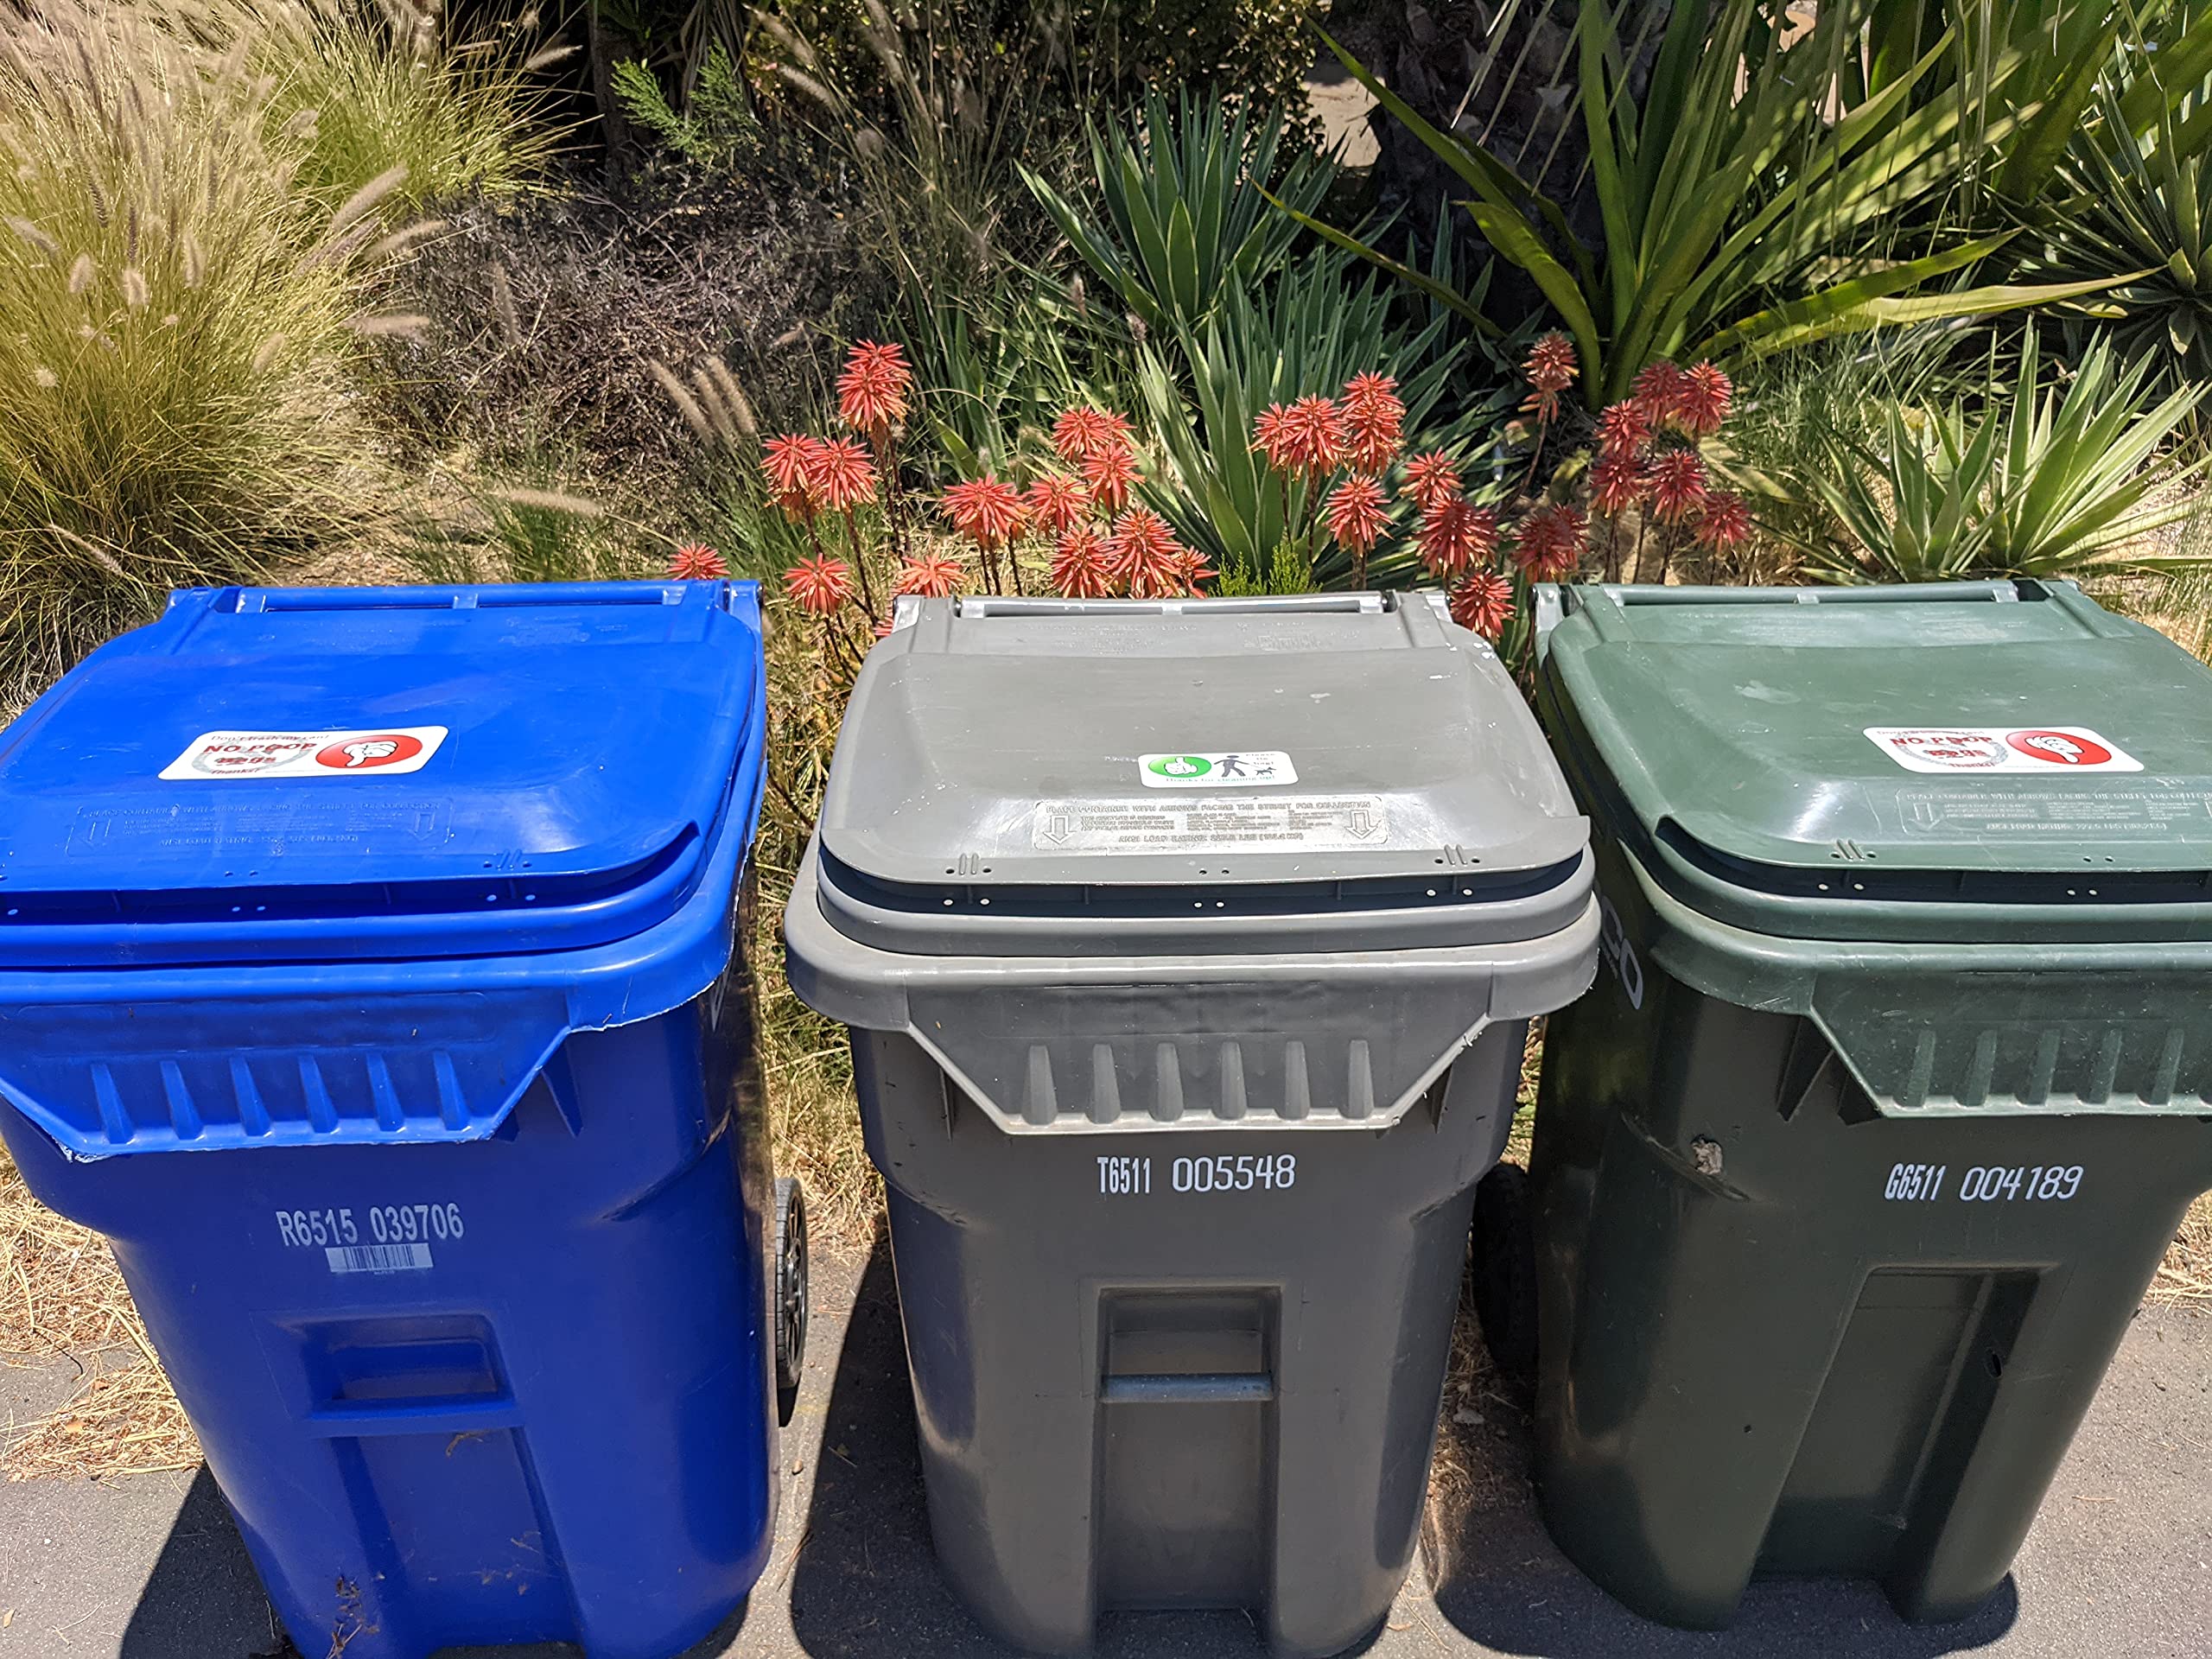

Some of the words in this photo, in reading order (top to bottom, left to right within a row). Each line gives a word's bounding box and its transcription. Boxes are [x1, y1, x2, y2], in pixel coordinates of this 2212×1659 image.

[248, 743, 318, 753] POOP
[1890, 737, 1924, 746] NO
[1930, 736, 1993, 747] POOP
[1096, 1156, 1151, 1193] T6511
[1172, 1154, 1296, 1192] 005548
[1885, 1163, 1946, 1200] G6511
[1960, 1166, 2084, 1201] 004189
[276, 1209, 358, 1246] R6515
[370, 1203, 464, 1243] 039706
